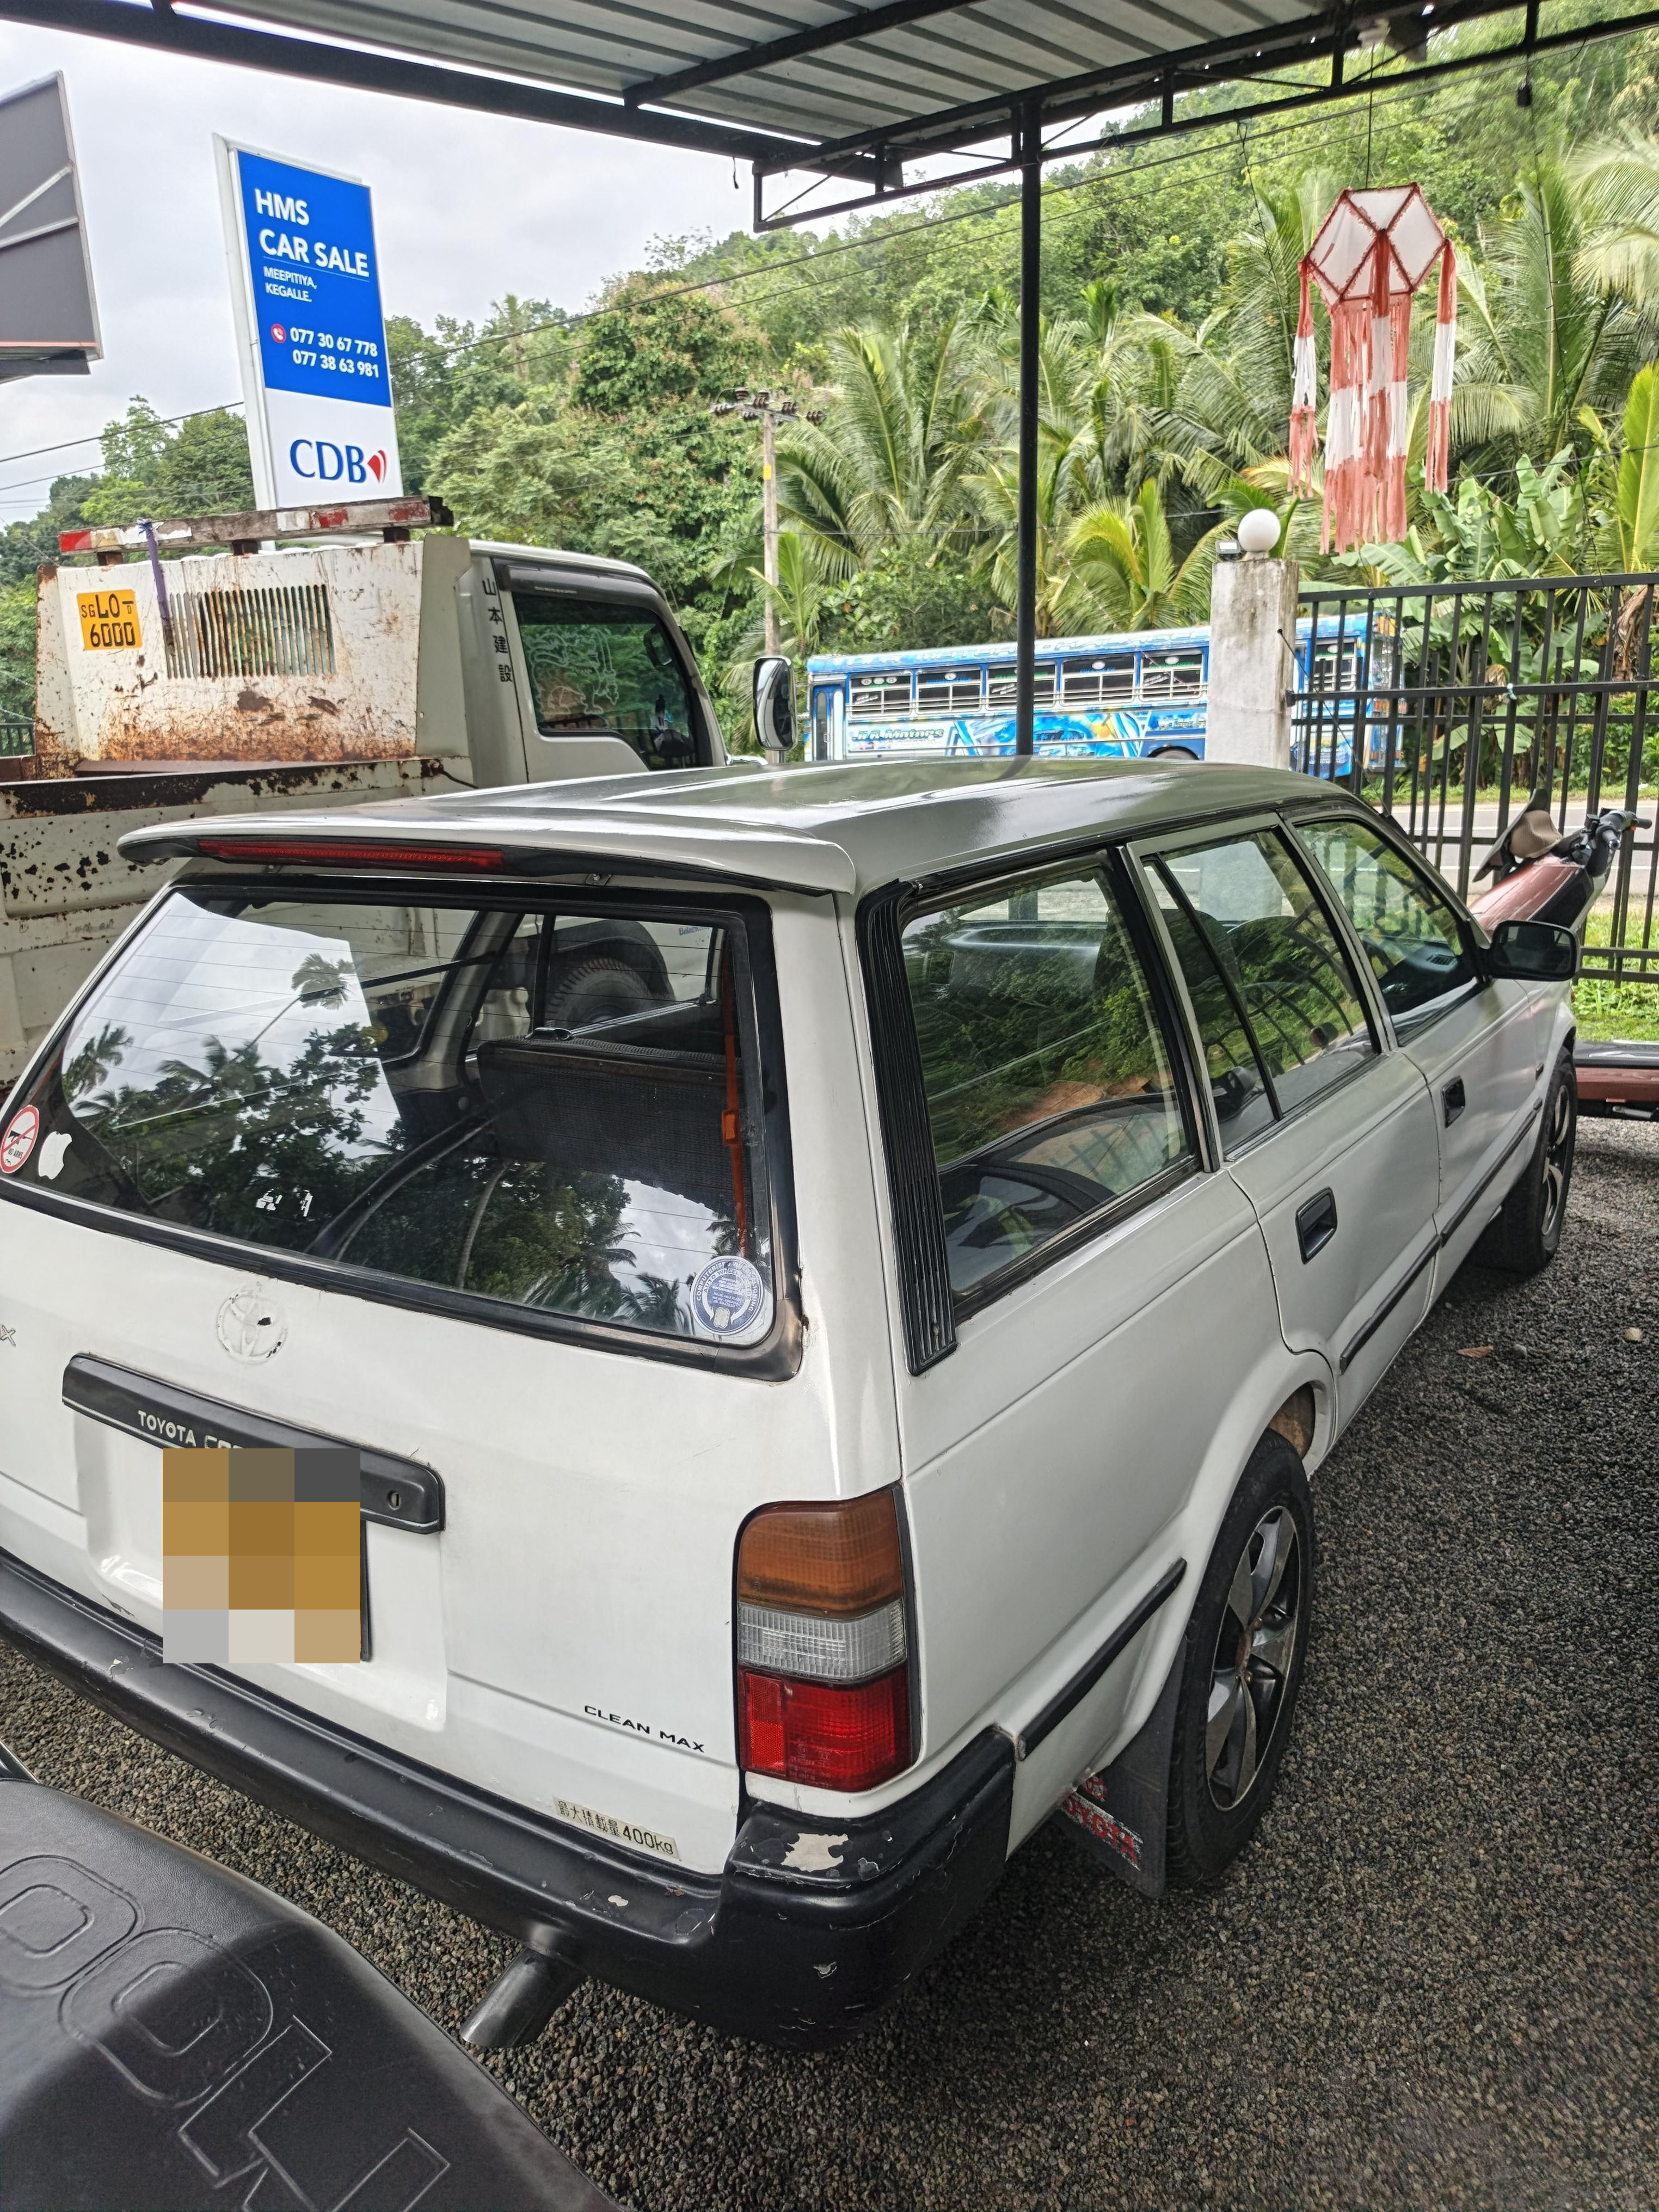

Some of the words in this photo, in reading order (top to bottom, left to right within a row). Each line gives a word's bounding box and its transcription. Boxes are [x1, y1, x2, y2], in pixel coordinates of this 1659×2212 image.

[254, 188, 310, 226] HMS
[259, 229, 310, 264] CAR
[314, 242, 370, 277] SALE
[263, 266, 317, 290] MEEPITIYA,
[265, 282, 312, 302] KEGALLE.
[290, 327, 314, 345] 077
[317, 333, 334, 349] 30
[336, 336, 352, 353] 67
[354, 339, 378, 357] 778
[292, 349, 317, 367] 077
[320, 354, 336, 371] 38
[339, 358, 355, 374] 63
[357, 361, 379, 378] 981
[290, 439, 366, 484] CDB
[81, 604, 95, 618] SG
[90, 622, 136, 648] 6000
[482, 577, 513, 683] 山本建設
[13, 1150, 23, 1159] ARMS
[703, 1274, 717, 1293] AUTO
[138, 1410, 196, 1447] TOYOTA
[584, 1704, 651, 1735] CLEAN
[660, 1730, 705, 1754] MAX
[623, 1825, 674, 1855] 400kg
